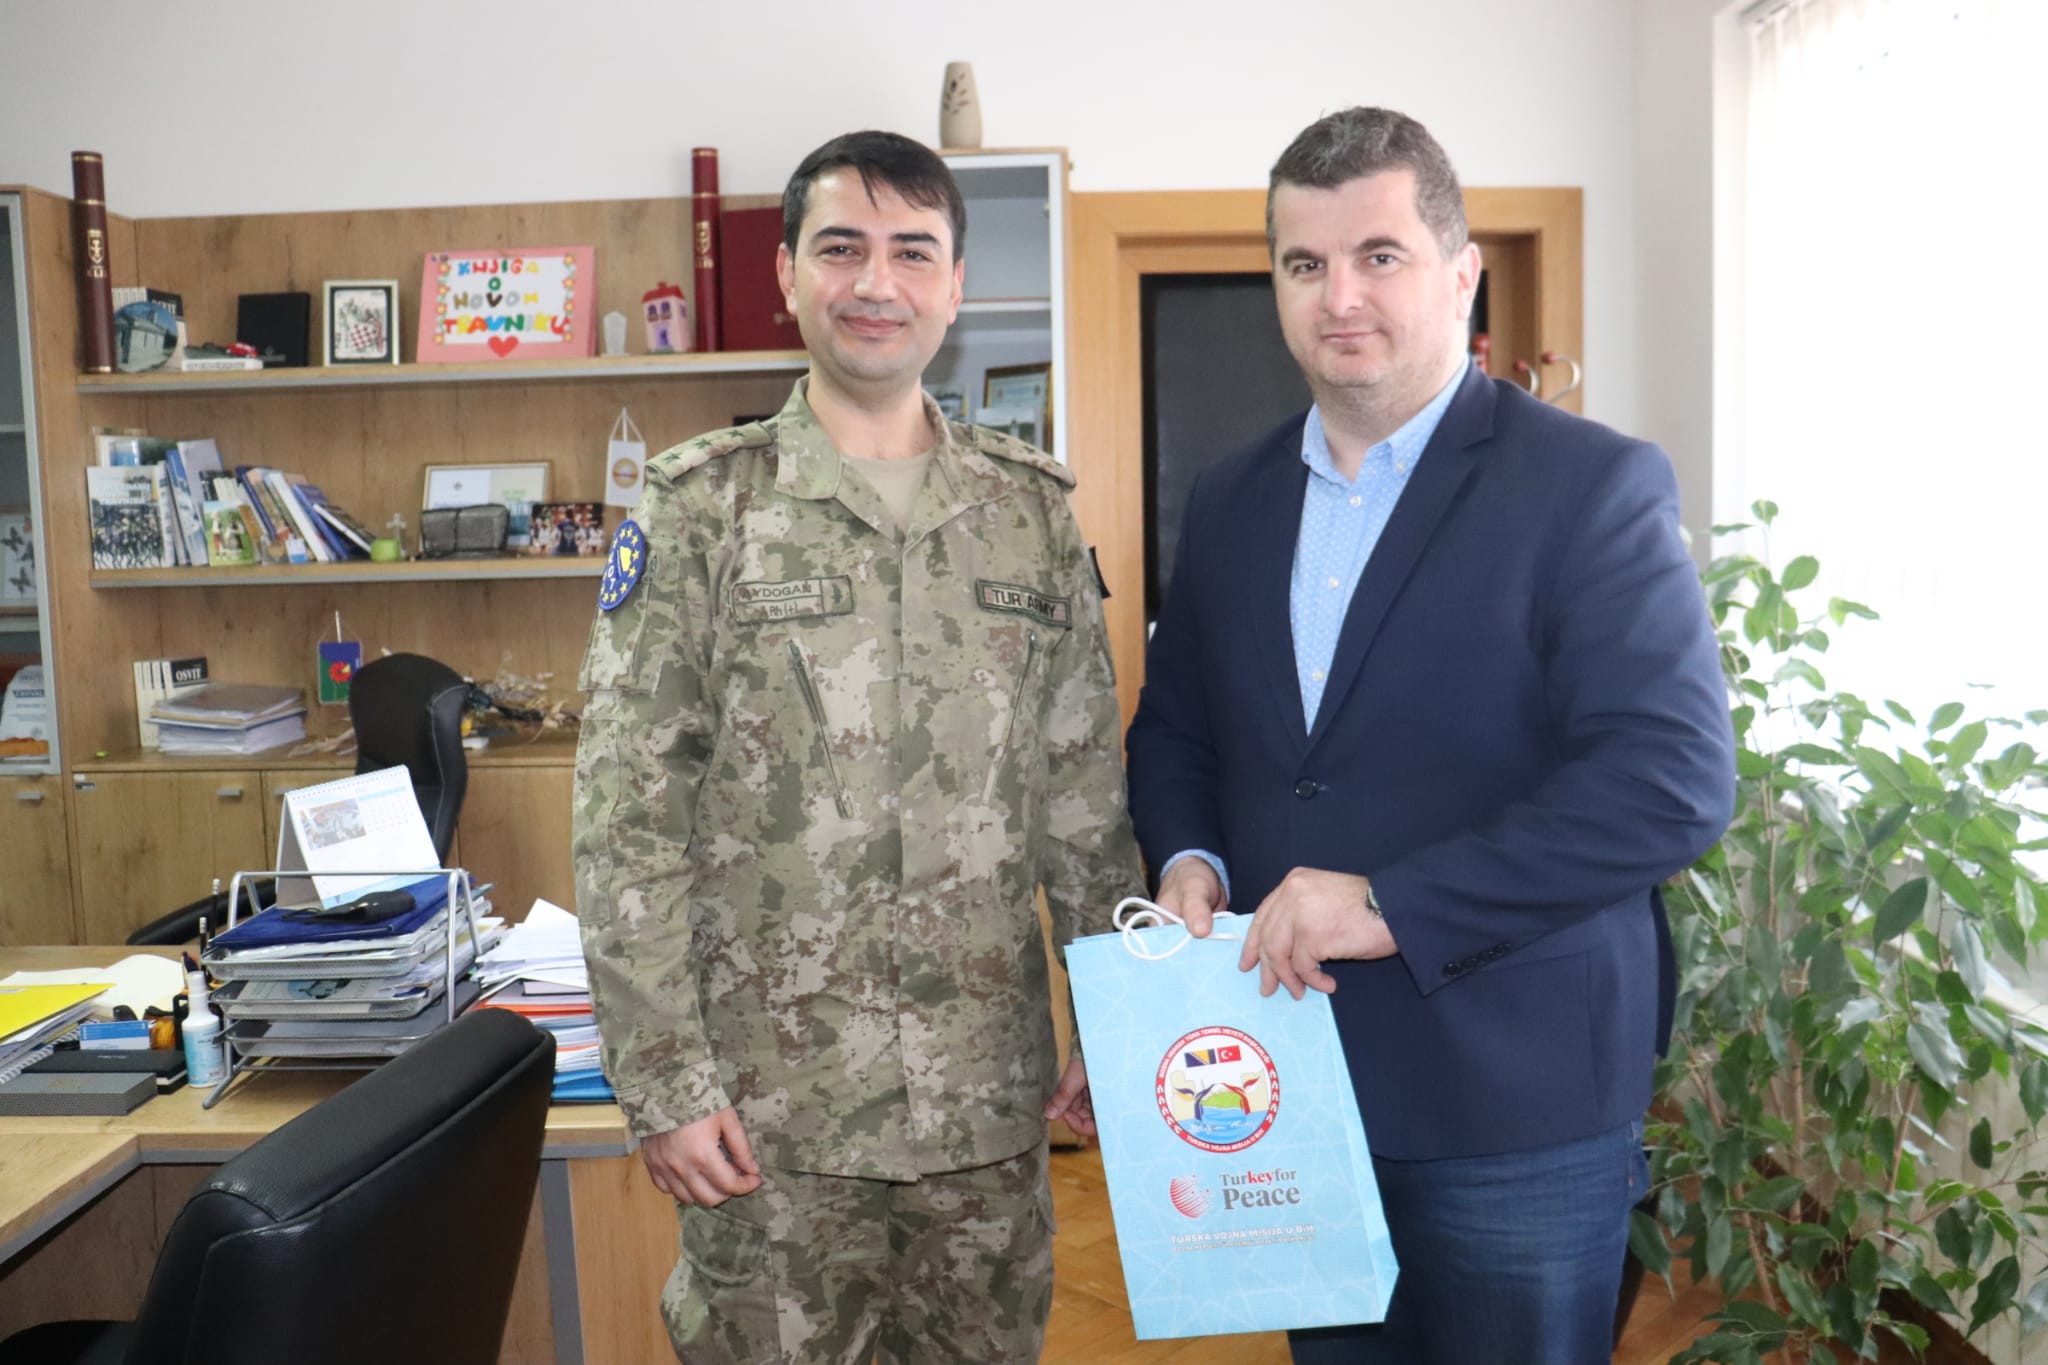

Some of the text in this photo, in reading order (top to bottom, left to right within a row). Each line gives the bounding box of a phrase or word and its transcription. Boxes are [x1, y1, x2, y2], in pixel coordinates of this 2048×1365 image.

[457, 258, 539, 276] KNJIGA
[488, 277, 501, 291] O
[453, 291, 539, 309] NOVOM
[443, 312, 571, 335] TRAVNIKU
[992, 589, 1056, 618] TUR ARMY
[1222, 1186, 1300, 1210] Peace
